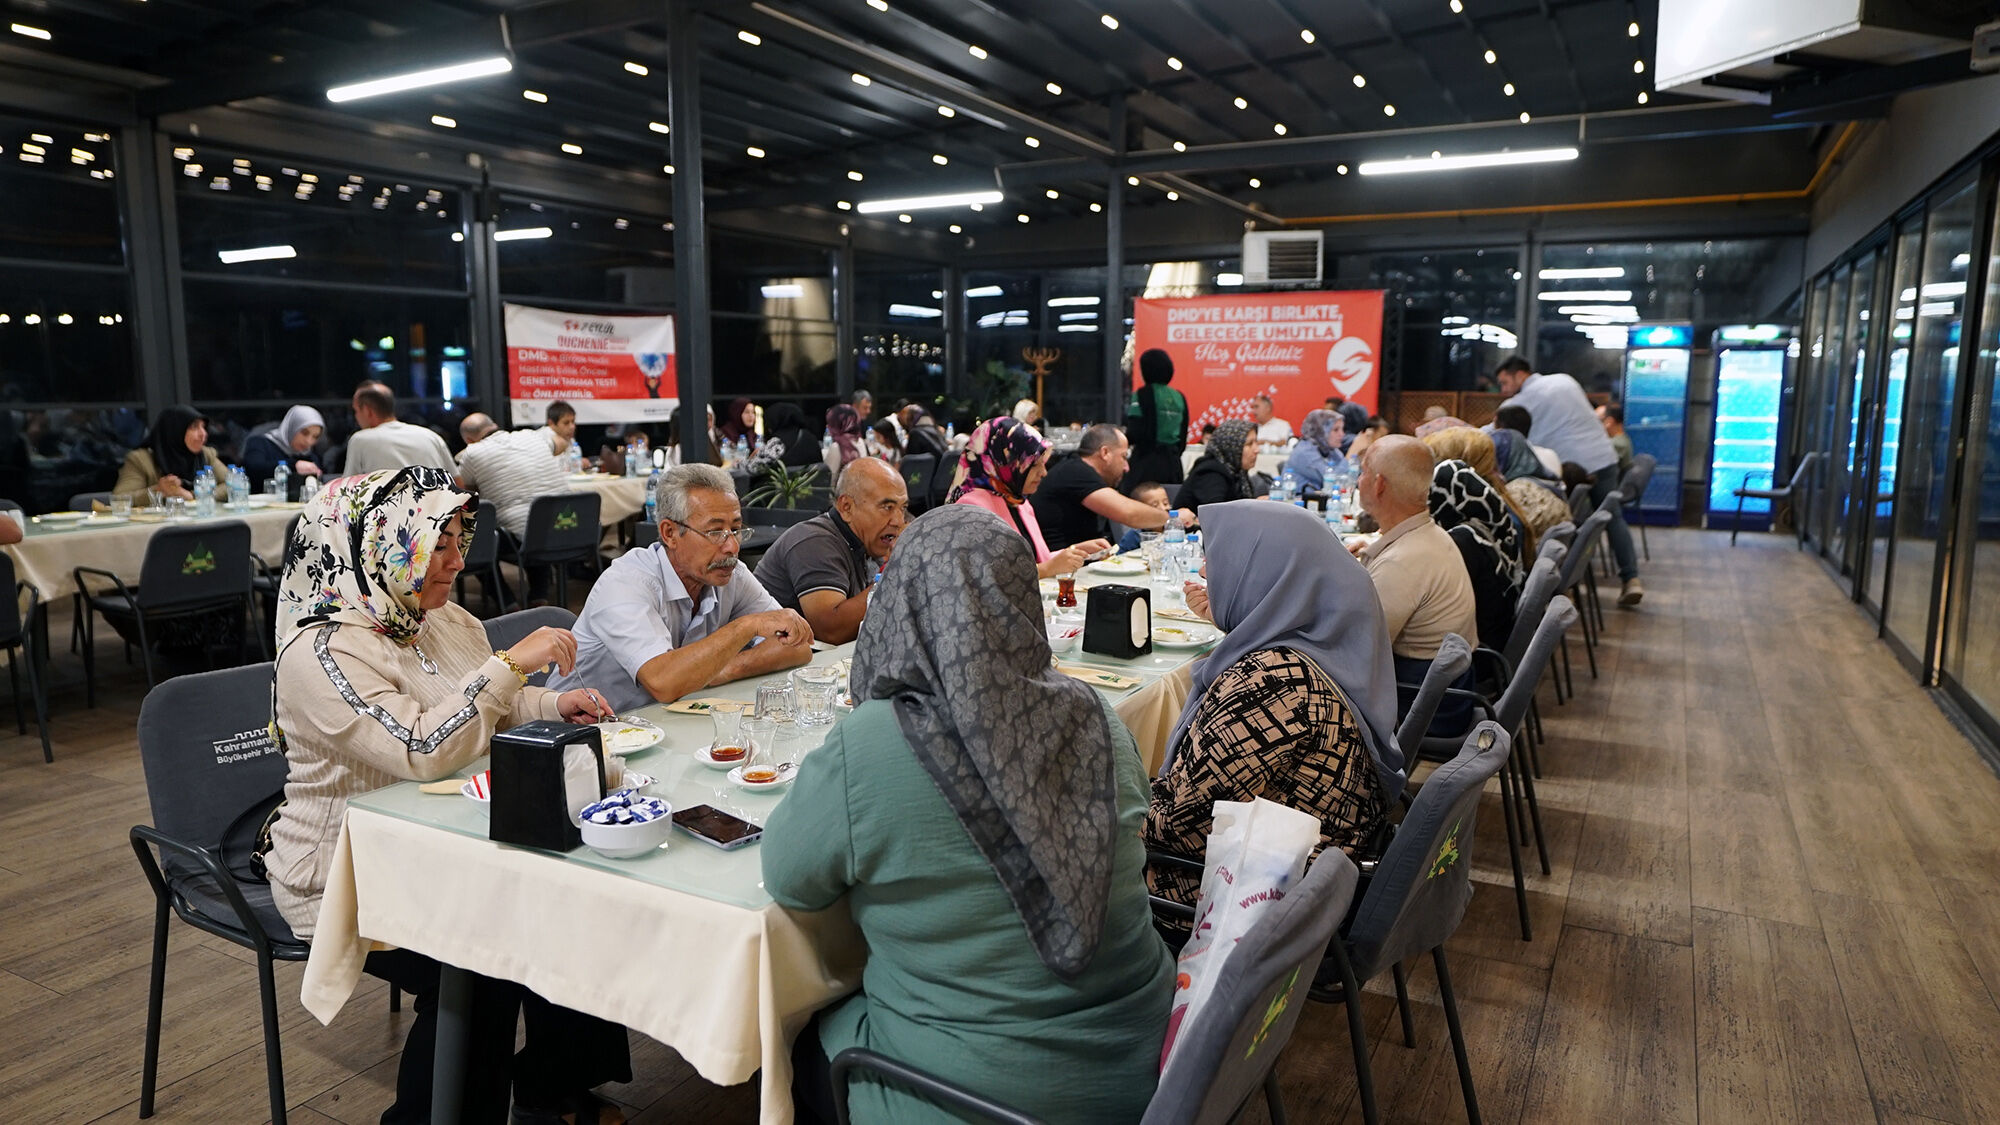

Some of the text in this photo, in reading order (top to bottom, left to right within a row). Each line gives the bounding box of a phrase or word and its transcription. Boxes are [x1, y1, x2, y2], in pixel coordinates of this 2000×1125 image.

[1167, 307, 1221, 322] DMD'YE
[1224, 306, 1268, 322] KARŞI
[1173, 323, 1335, 340] GELECEĞE UMUTLA
[518, 349, 548, 361] DMD
[1194, 342, 1304, 364] Hoş Geldiniz
[216, 749, 262, 764] Büyükşehir
